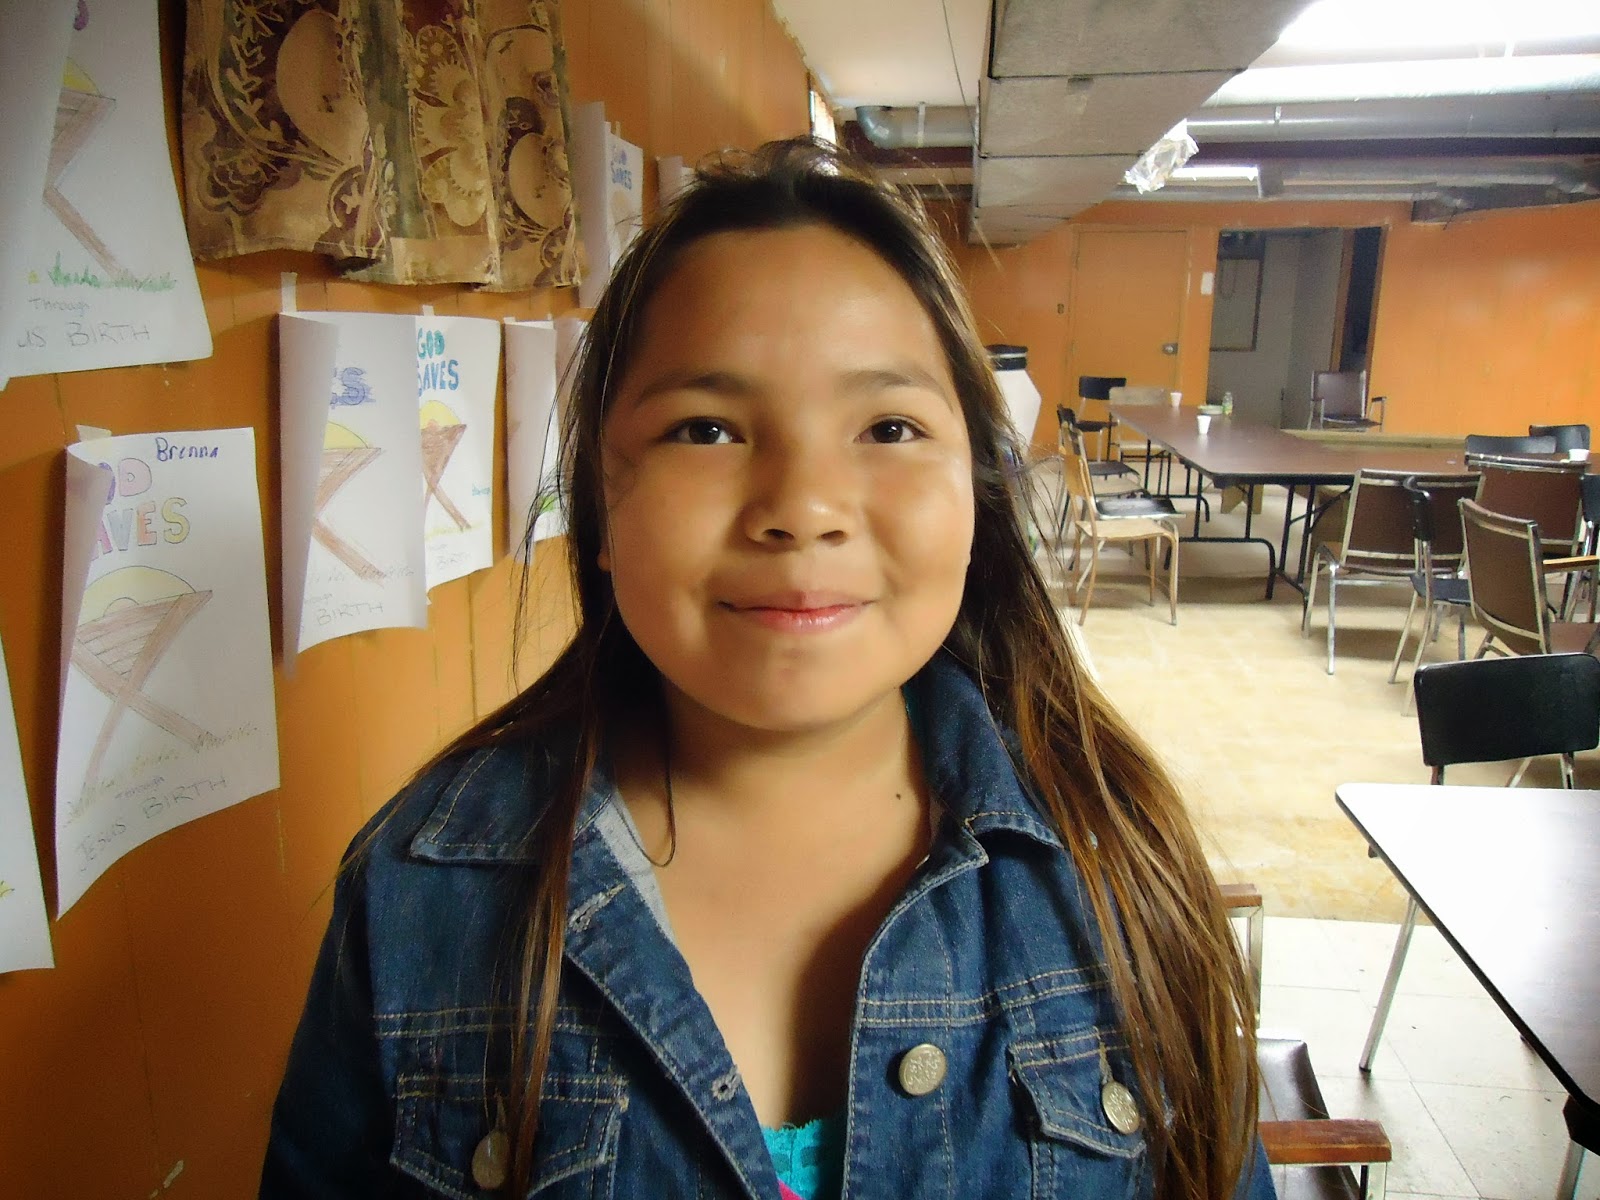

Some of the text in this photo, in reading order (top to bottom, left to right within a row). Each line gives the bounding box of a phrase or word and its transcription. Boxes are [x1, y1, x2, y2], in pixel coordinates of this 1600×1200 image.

[67, 320, 150, 347] BIRTH
[416, 327, 445, 359] GOD
[317, 602, 384, 626] BIRTH
[141, 770, 228, 820] BIRTH
